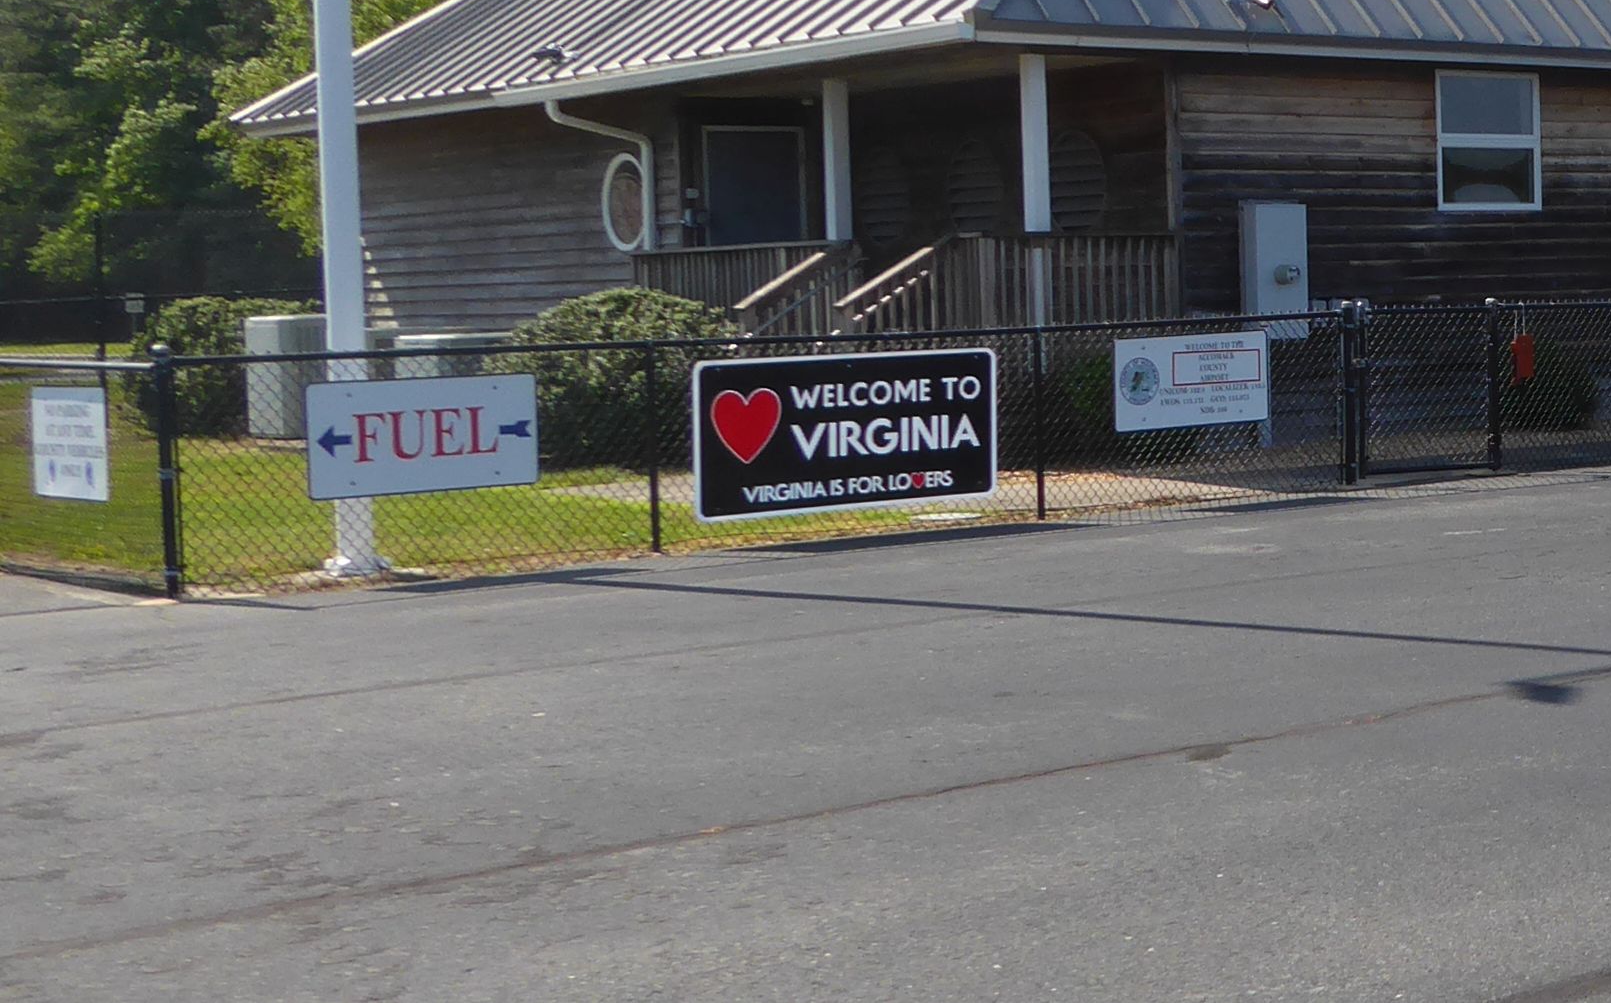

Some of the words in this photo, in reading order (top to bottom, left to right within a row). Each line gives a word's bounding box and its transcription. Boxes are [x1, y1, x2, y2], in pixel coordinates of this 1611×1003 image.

[790, 378, 931, 410] WELCOME
[941, 375, 982, 400] TO
[352, 406, 498, 464] FUEL
[790, 413, 981, 461] VIRGINIA
[741, 479, 826, 504] VIRGINIA
[829, 480, 844, 497] IS
[848, 476, 885, 496] FOR
